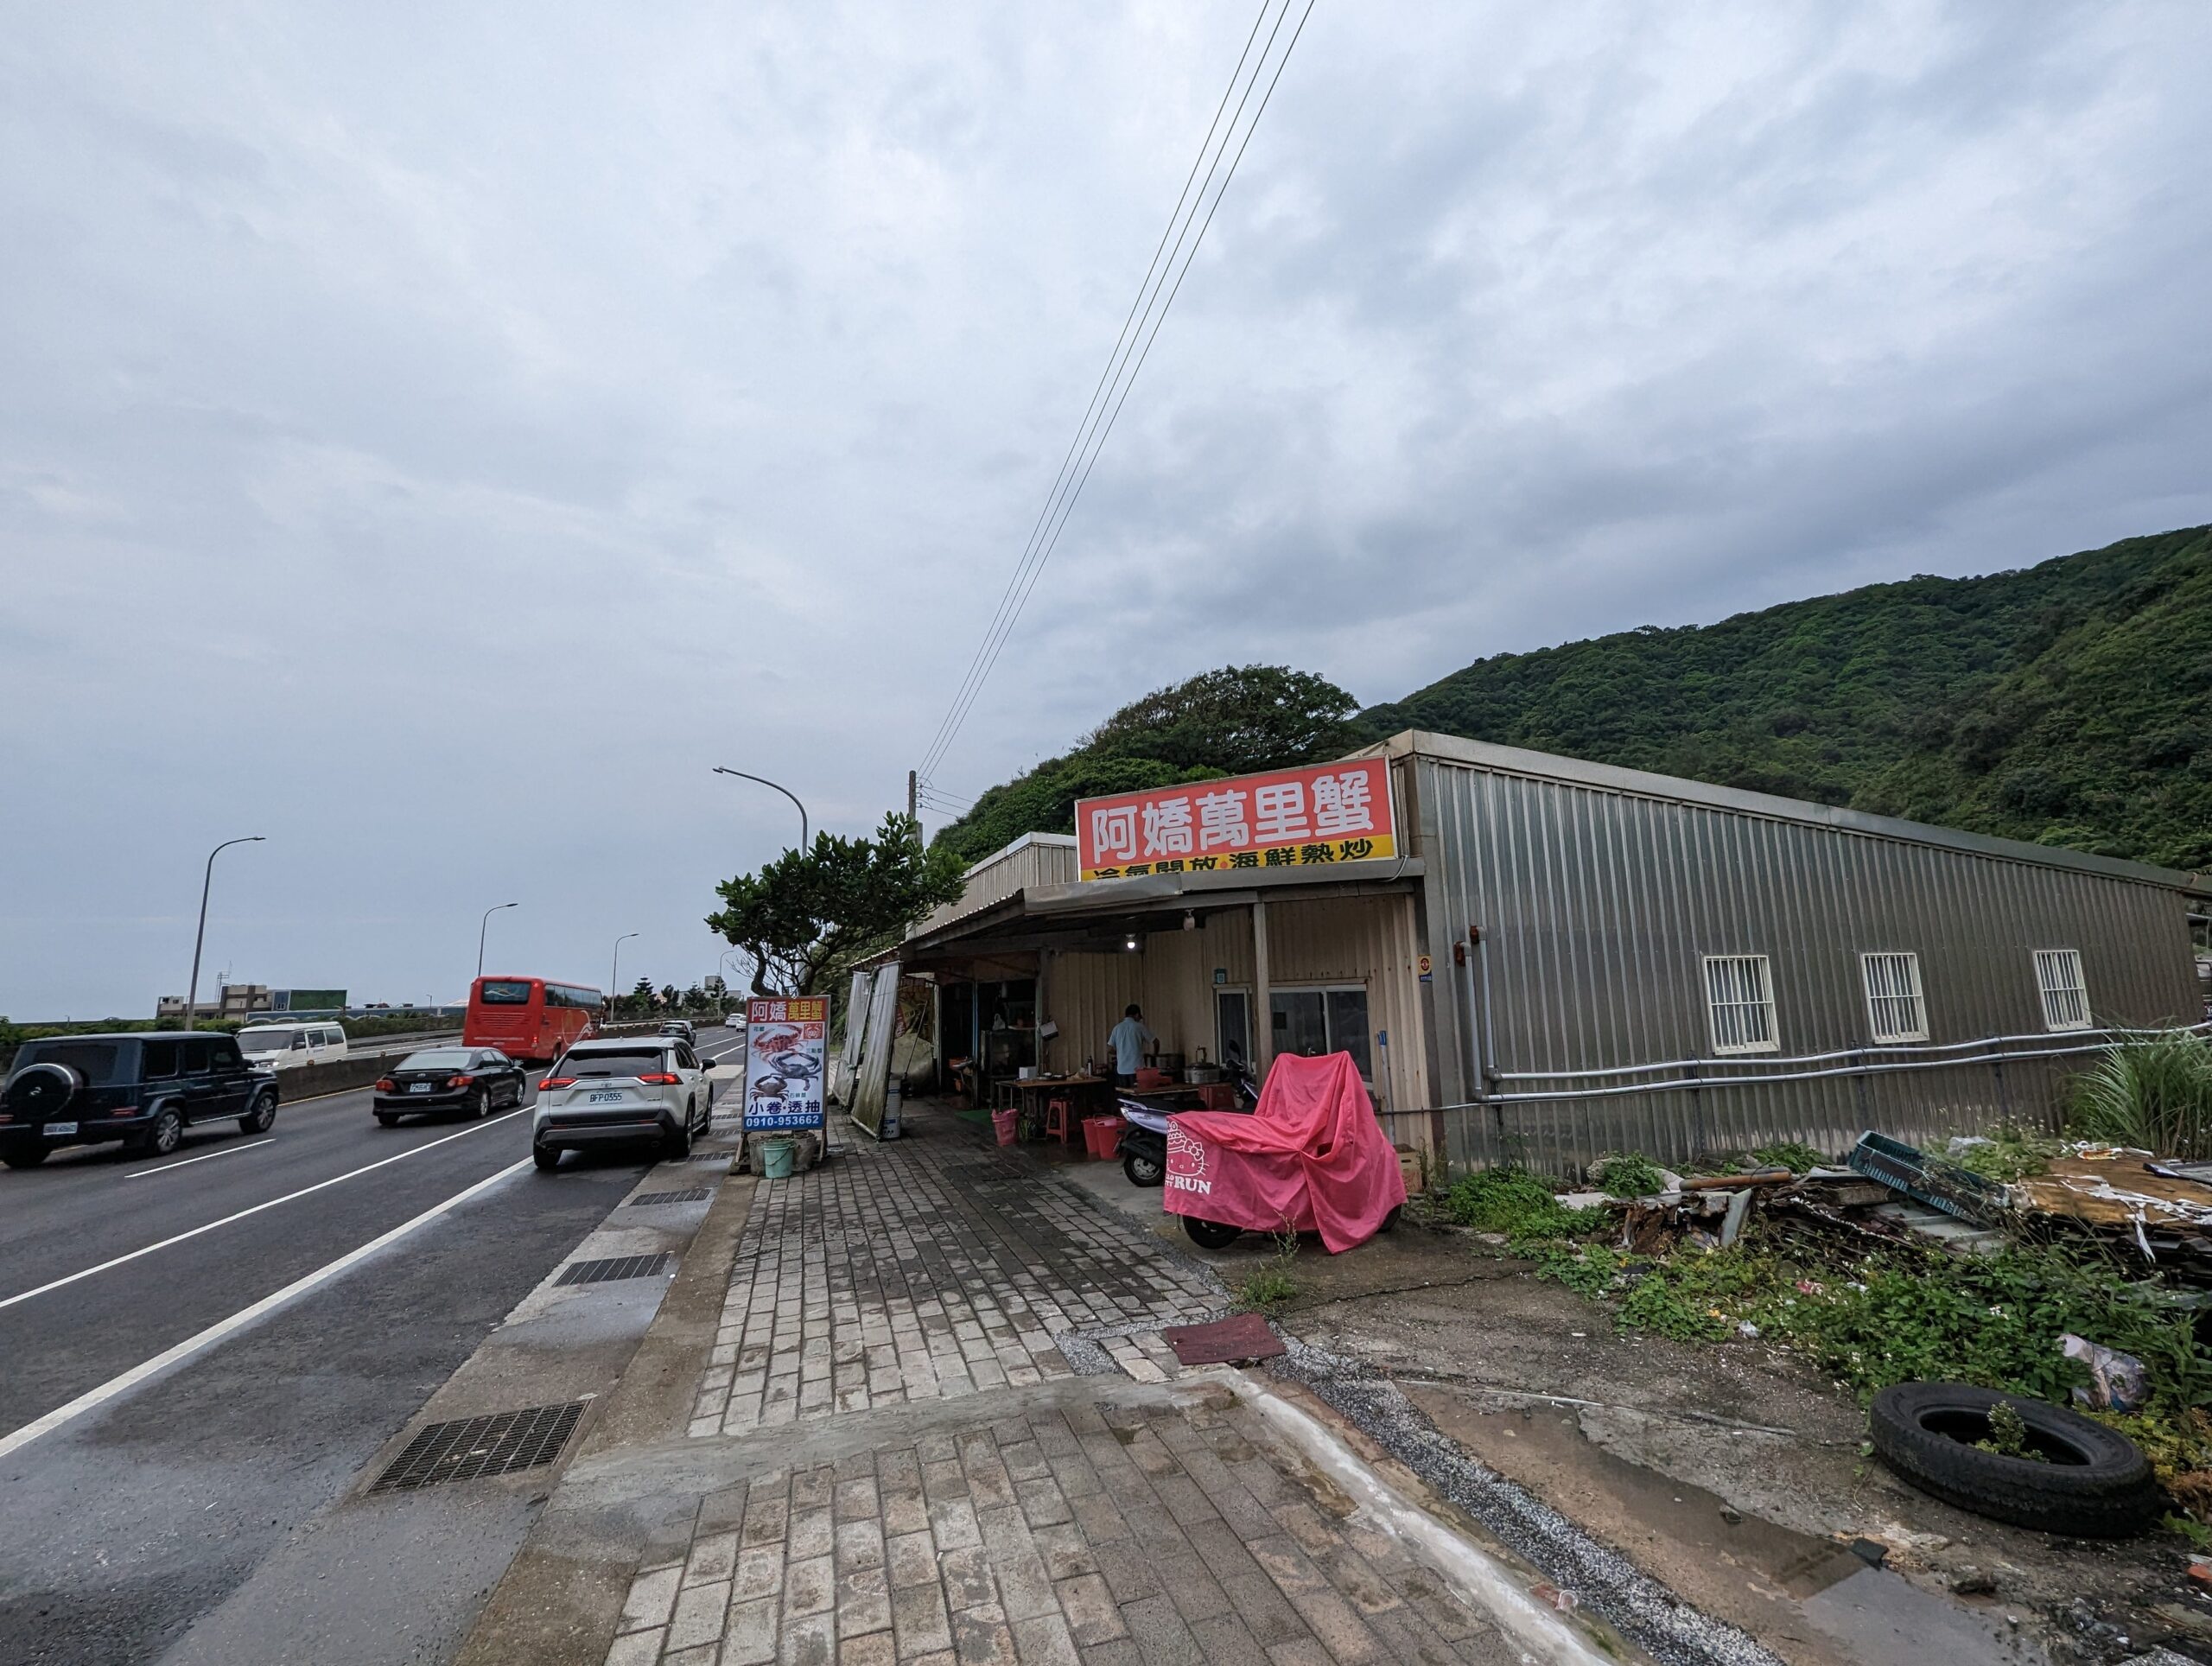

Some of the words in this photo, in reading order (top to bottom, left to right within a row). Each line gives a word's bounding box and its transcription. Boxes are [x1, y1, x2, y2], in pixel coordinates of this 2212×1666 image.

[1091, 769, 1374, 863] 阿嬌萬里蟹
[746, 1115, 819, 1127] 0910-953662
[1173, 1175, 1211, 1195] RUN
